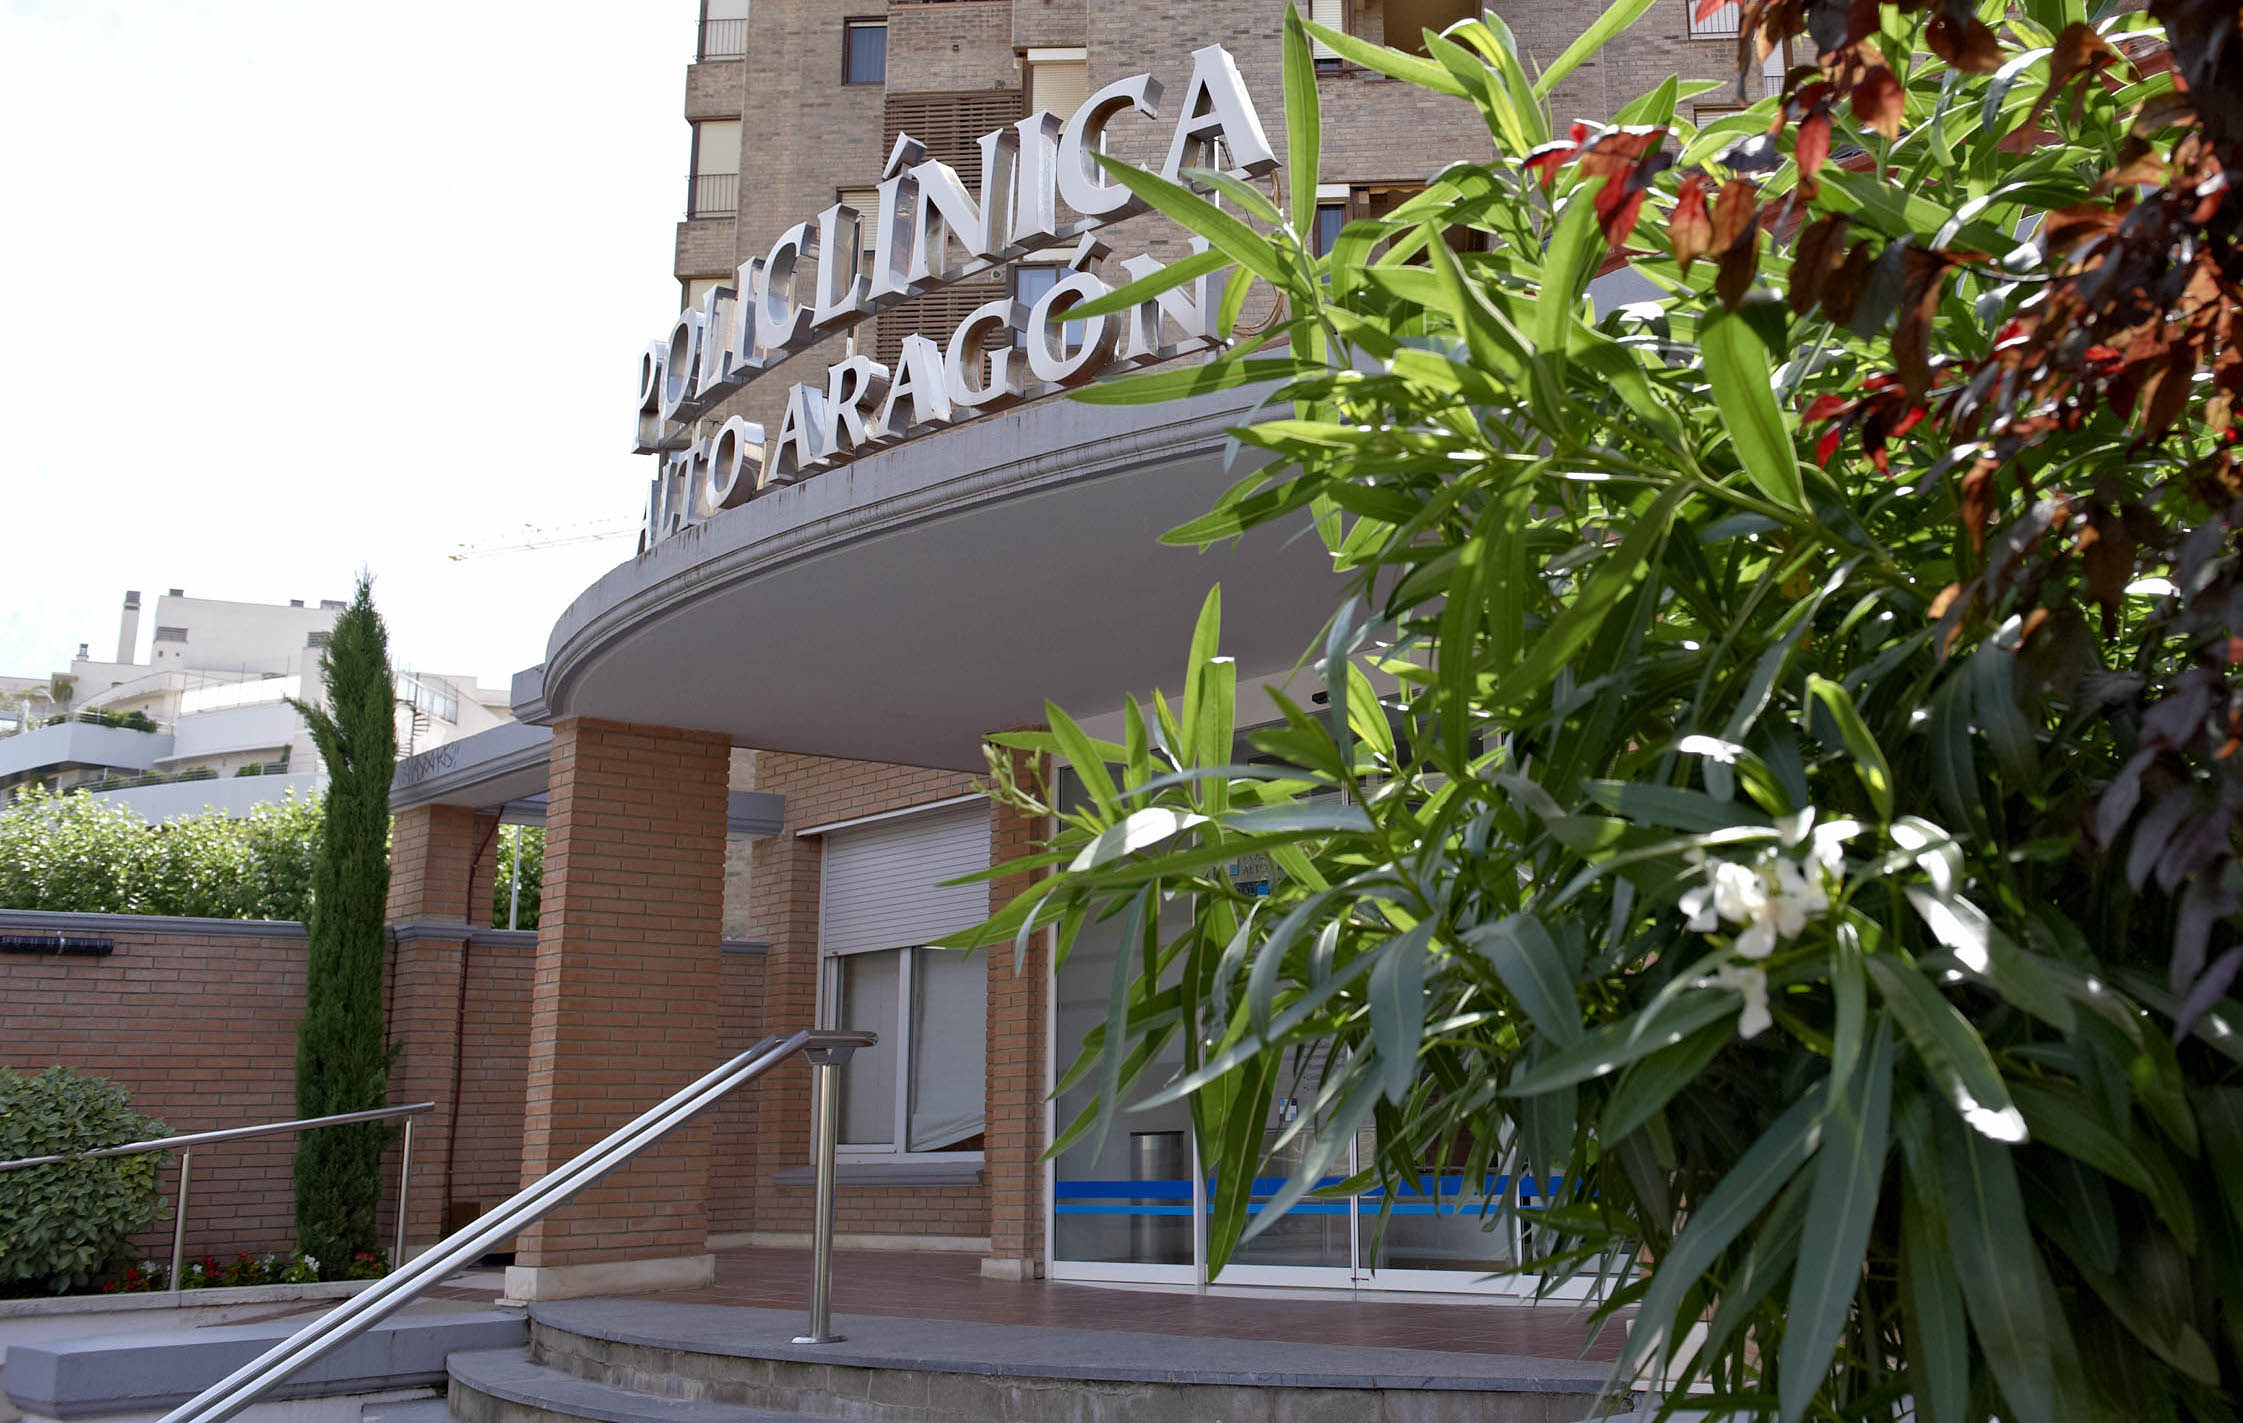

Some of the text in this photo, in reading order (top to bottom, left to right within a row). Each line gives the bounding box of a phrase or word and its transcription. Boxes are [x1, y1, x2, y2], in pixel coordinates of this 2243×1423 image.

[632, 43, 1281, 454] POLICLÍNICA
[637, 231, 1220, 555] ALTO ARAGÓN
